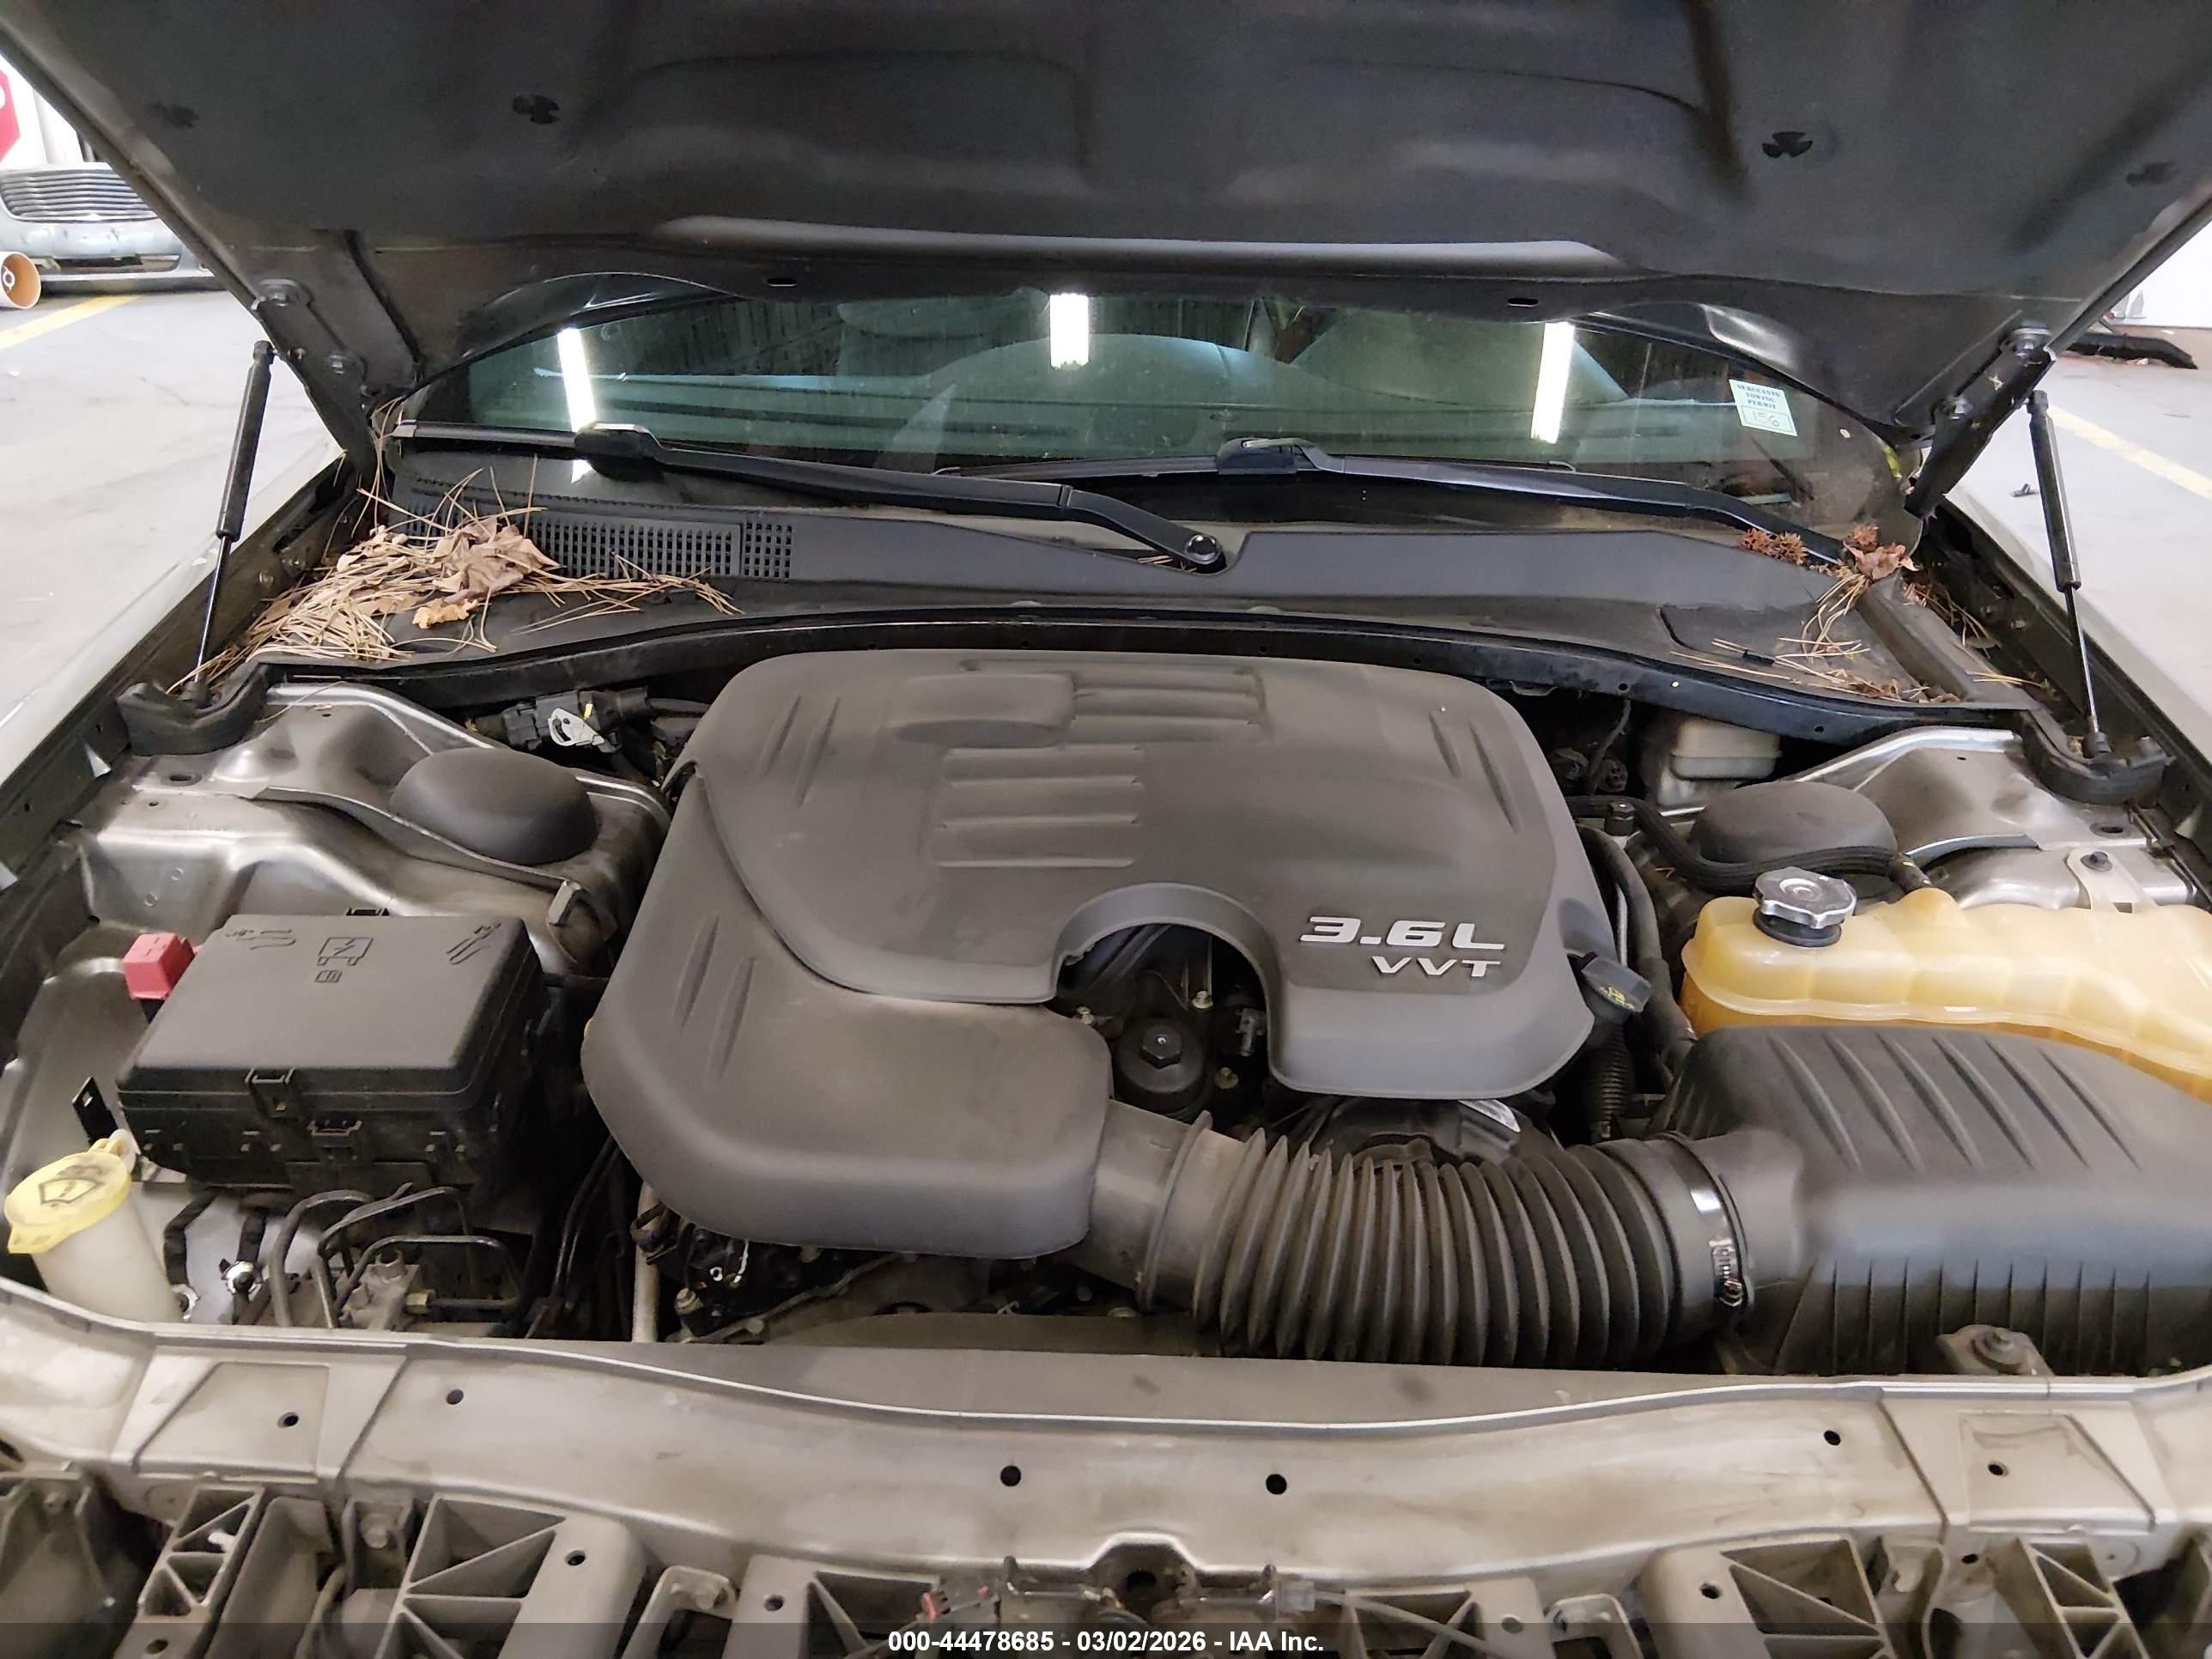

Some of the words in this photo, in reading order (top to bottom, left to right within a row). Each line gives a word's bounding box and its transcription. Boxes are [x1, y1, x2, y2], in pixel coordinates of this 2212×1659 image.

[1747, 399, 1776, 410] PERMIT
[1299, 915, 1505, 951] 3.6L
[1371, 955, 1501, 977] VVT
